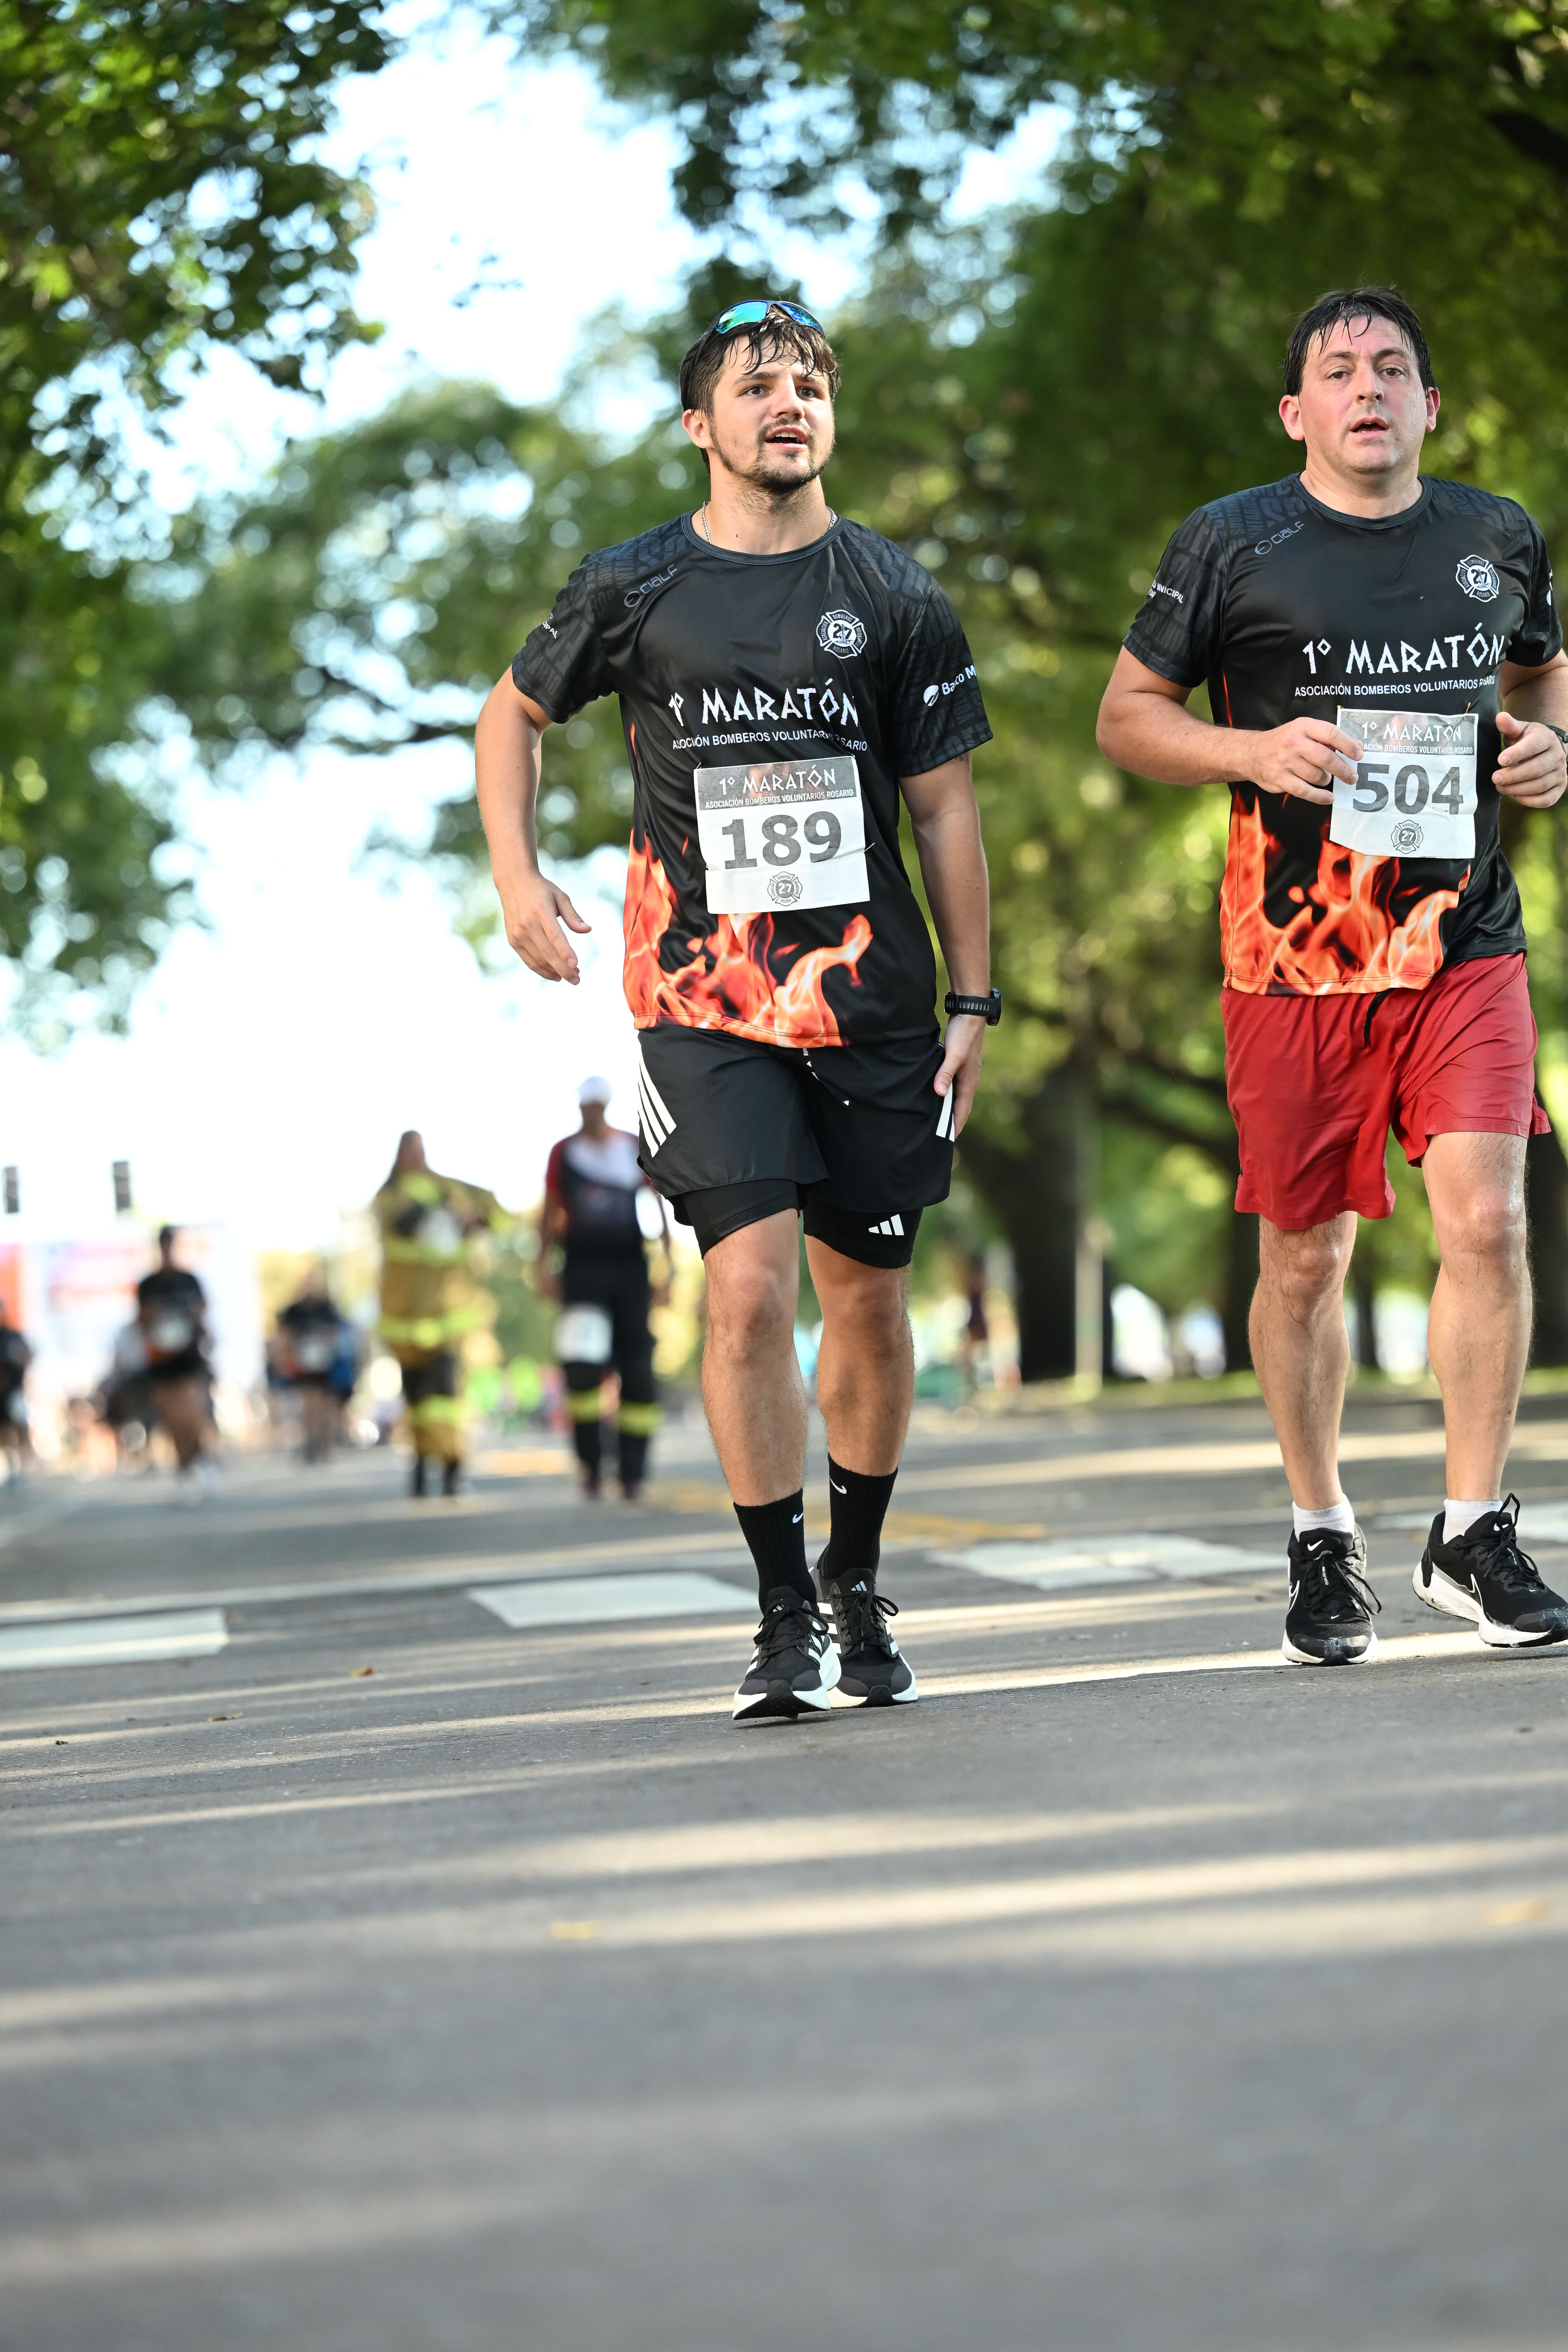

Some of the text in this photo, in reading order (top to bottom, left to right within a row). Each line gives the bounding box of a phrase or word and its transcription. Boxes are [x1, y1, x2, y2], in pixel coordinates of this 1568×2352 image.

[1471, 569, 1488, 584] 27
[832, 614, 853, 622] BOMBEROS
[833, 623, 852, 640] 27
[833, 646, 849, 654] ROSARIO
[1345, 622, 1505, 674] MARATÓN
[942, 673, 964, 695] Baco
[1295, 683, 1351, 697] ASOCIACIÓN
[1354, 684, 1411, 695] BOMBEROS
[1414, 679, 1478, 692] VOLUNTARIOS
[702, 677, 859, 727] MARATÓN
[712, 733, 770, 746] BOMBEROS
[1383, 721, 1462, 742] MARATÓN
[1384, 744, 1418, 753] BOMBEROS
[742, 764, 836, 794] MARATÓN
[1353, 763, 1464, 815] 504
[705, 789, 854, 809] ASOCIACIÓN BOMBEROS VOLUNTARIOS ROSARIO
[721, 811, 842, 870] 189
[1401, 830, 1415, 842] 27
[778, 882, 792, 894] 27
